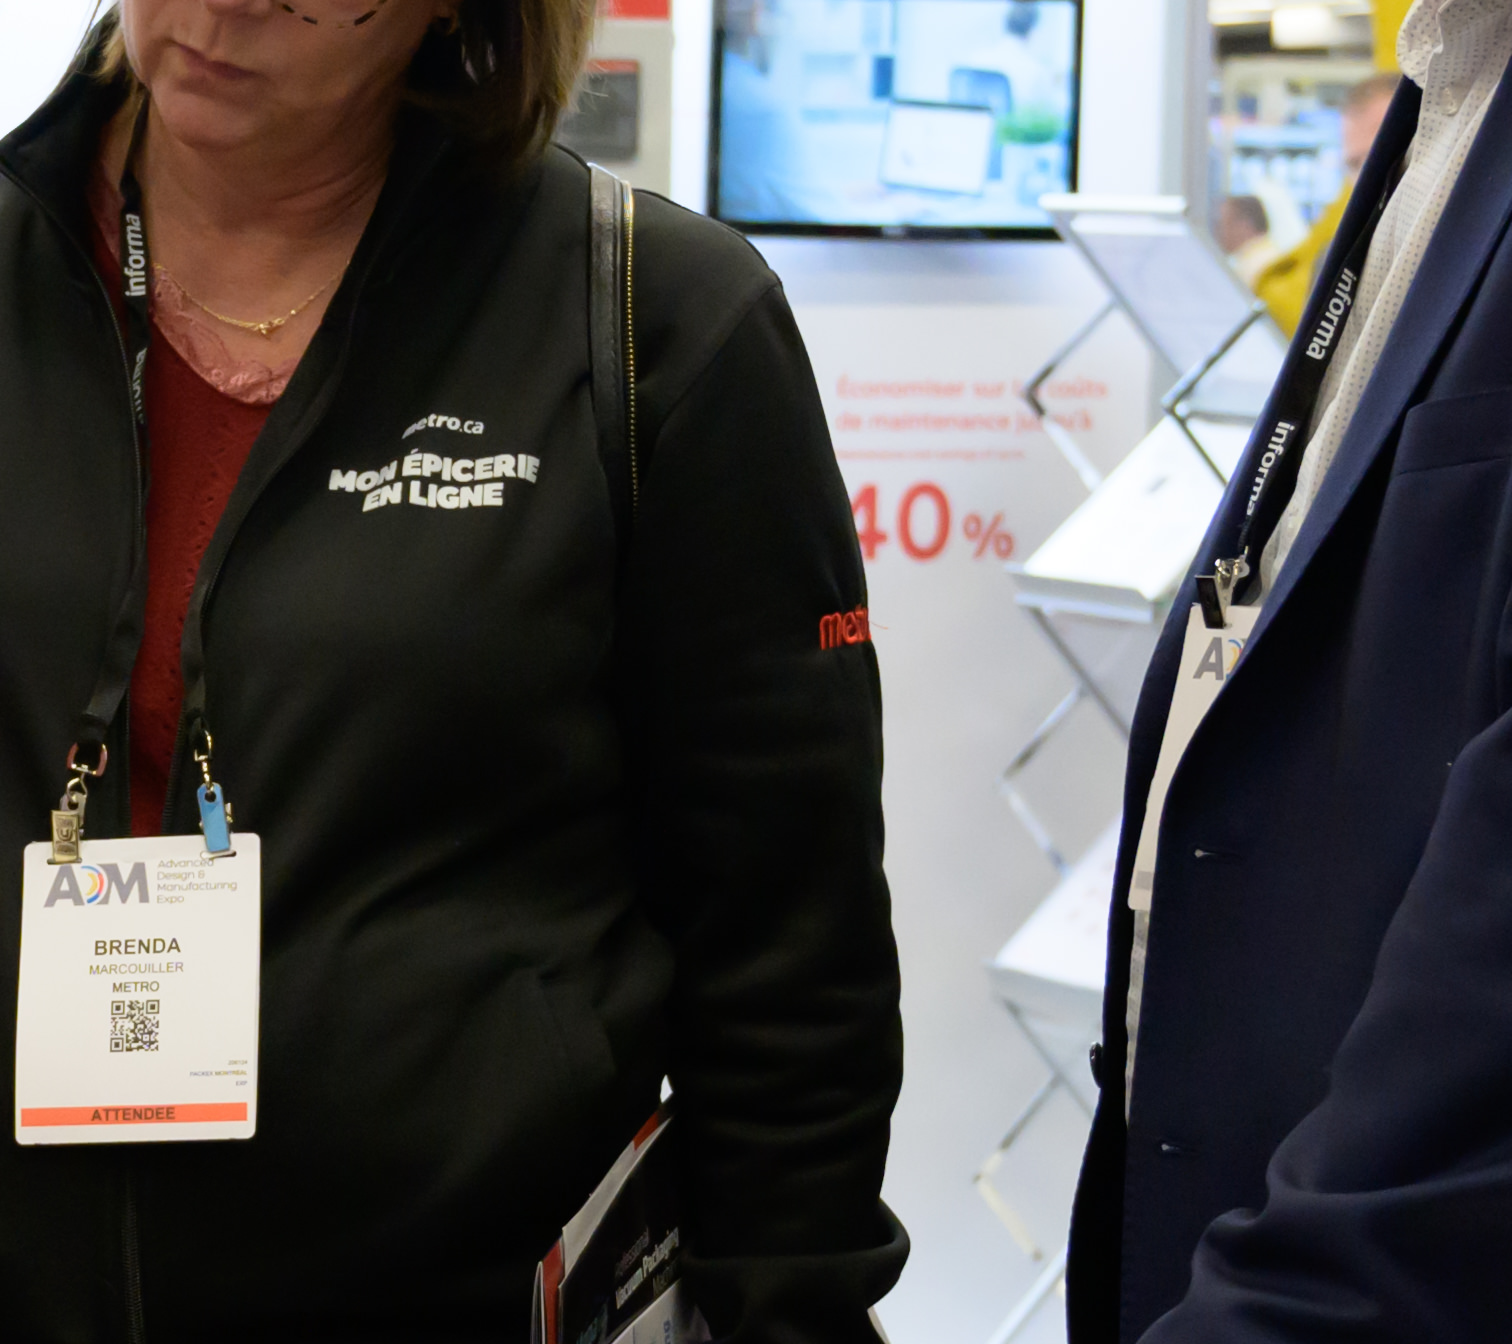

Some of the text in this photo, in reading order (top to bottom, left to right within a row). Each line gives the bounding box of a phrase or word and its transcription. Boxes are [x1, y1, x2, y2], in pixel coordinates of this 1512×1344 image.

[124, 213, 147, 297] informa
[1306, 267, 1357, 361] informa
[328, 447, 540, 492] MON ÉPICERIE
[362, 480, 504, 513] EN LIGNE
[158, 859, 214, 869] Advanced
[157, 870, 206, 882] Design &
[157, 881, 238, 892] Manufacturing
[157, 894, 185, 905] Expo
[94, 937, 181, 956] BRENDA
[89, 962, 184, 976] MARCOUILLER
[112, 981, 160, 994] METRO
[91, 1106, 176, 1122] ATTENDEE
